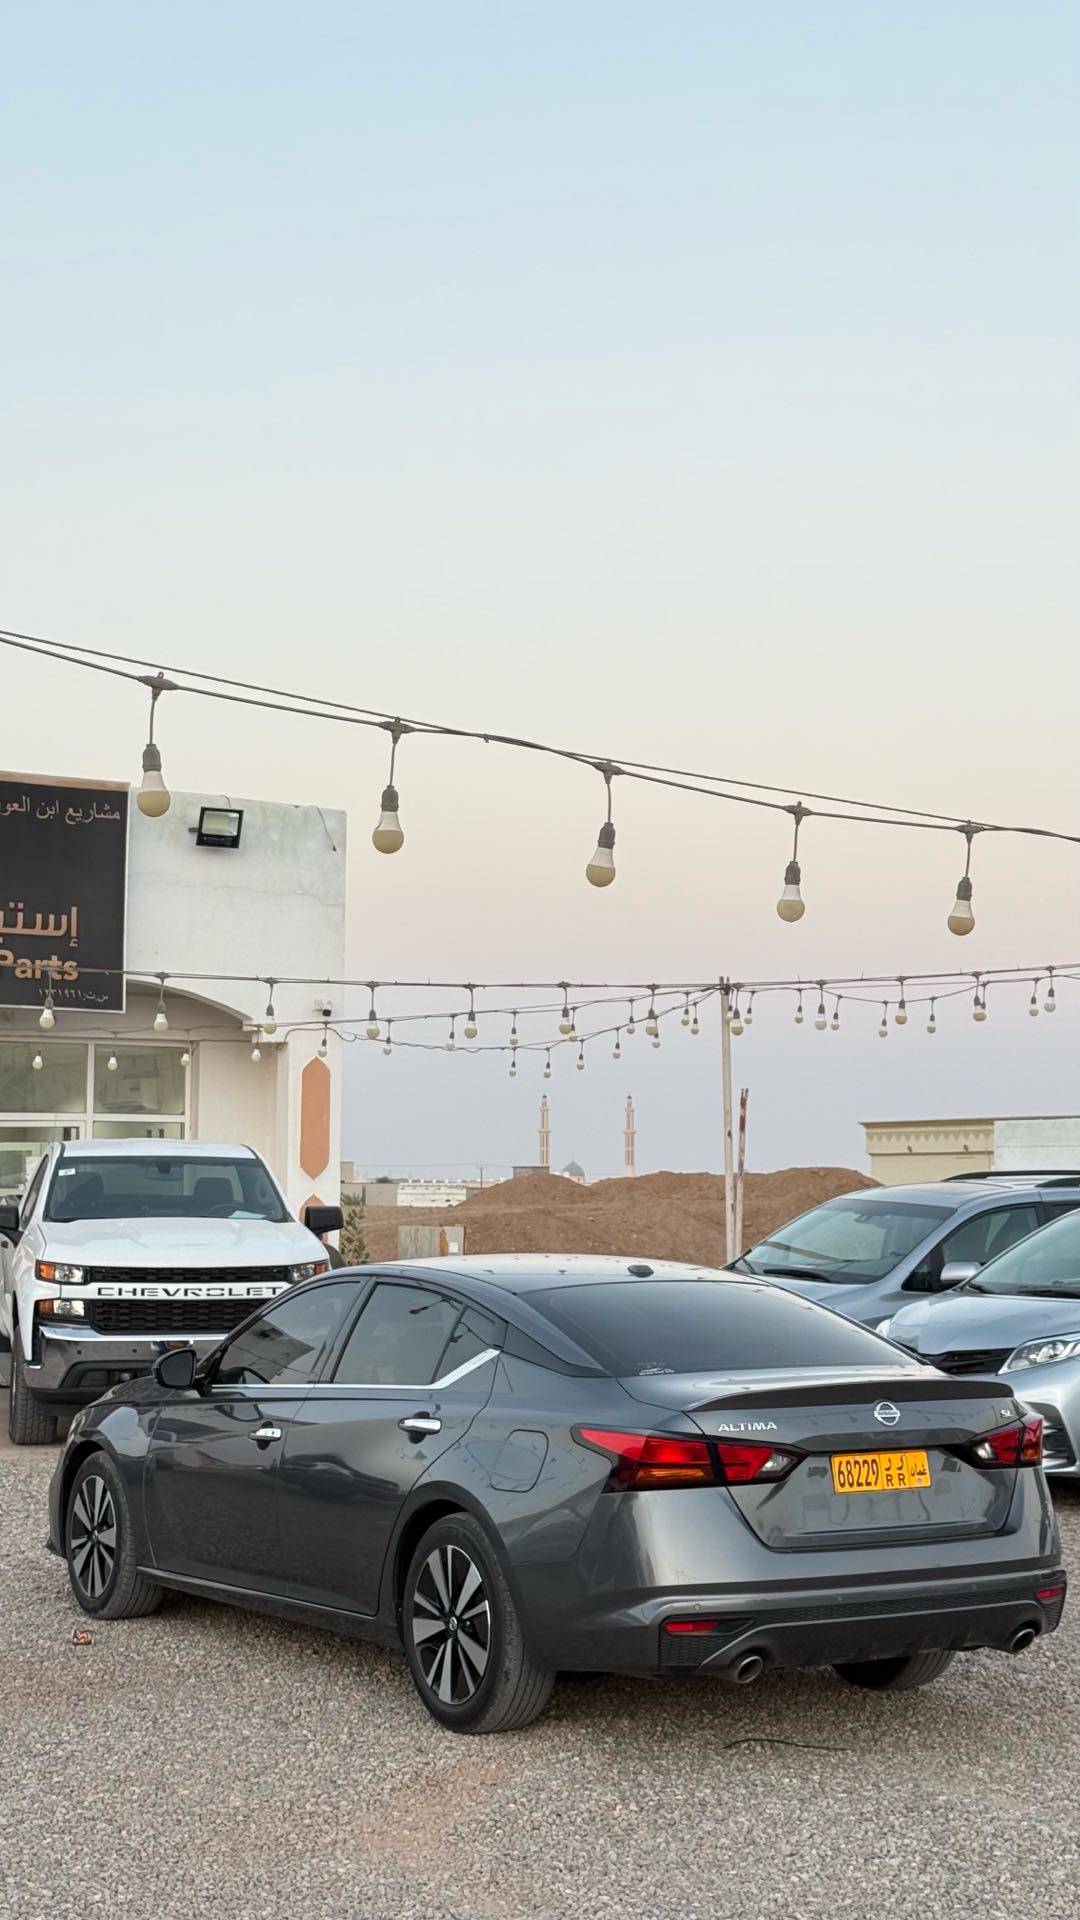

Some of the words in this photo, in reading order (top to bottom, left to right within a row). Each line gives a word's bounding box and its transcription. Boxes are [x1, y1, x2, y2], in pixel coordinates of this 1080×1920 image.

[0, 794, 30, 816] العو
[36, 799, 59, 820] ابن
[64, 801, 120, 825] مشاريع
[0, 949, 79, 981] Parts
[97, 1286, 283, 1297] CHEVROLET
[1000, 1409, 1014, 1418] SL
[718, 1421, 778, 1432] ALTIMA
[838, 1458, 879, 1488] 68229
